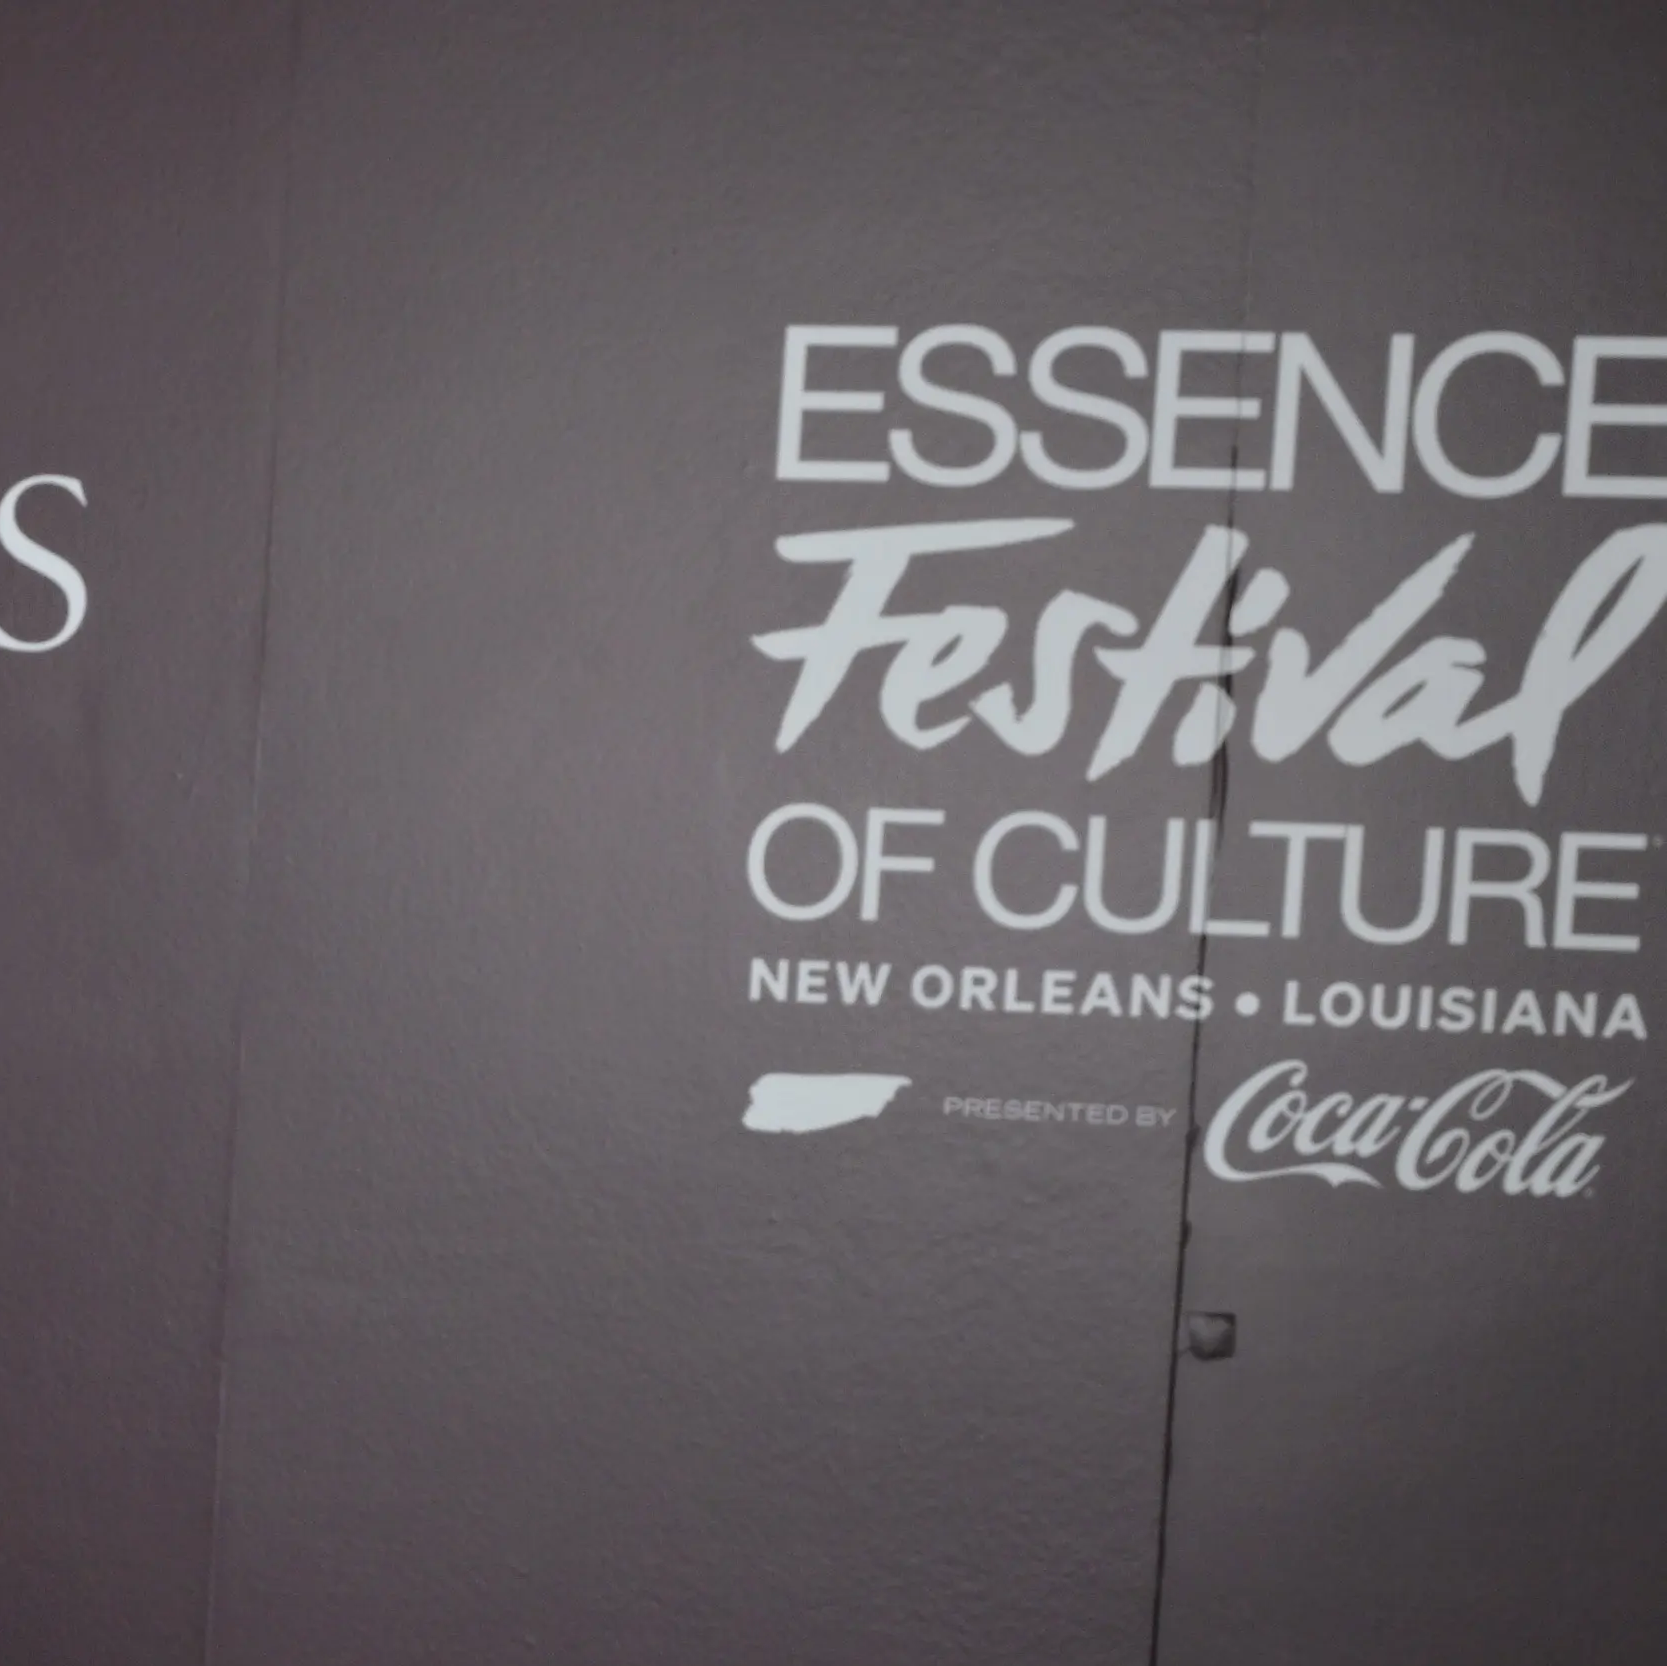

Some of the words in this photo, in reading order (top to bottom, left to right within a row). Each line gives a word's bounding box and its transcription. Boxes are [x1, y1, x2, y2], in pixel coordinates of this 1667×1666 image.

[775, 323, 1667, 500] ESSENCE
[750, 517, 1667, 808] Festival
[747, 802, 945, 921] OF
[973, 810, 1648, 952] CULTURE
[749, 958, 892, 1005] NEW
[911, 963, 1213, 1021] ORLEANS
[1283, 980, 1649, 1040] LOUISIANA
[943, 1097, 1128, 1125] PRESENTED
[1134, 1107, 1178, 1129] BY
[1203, 1059, 1636, 1197] Coca-Cola
